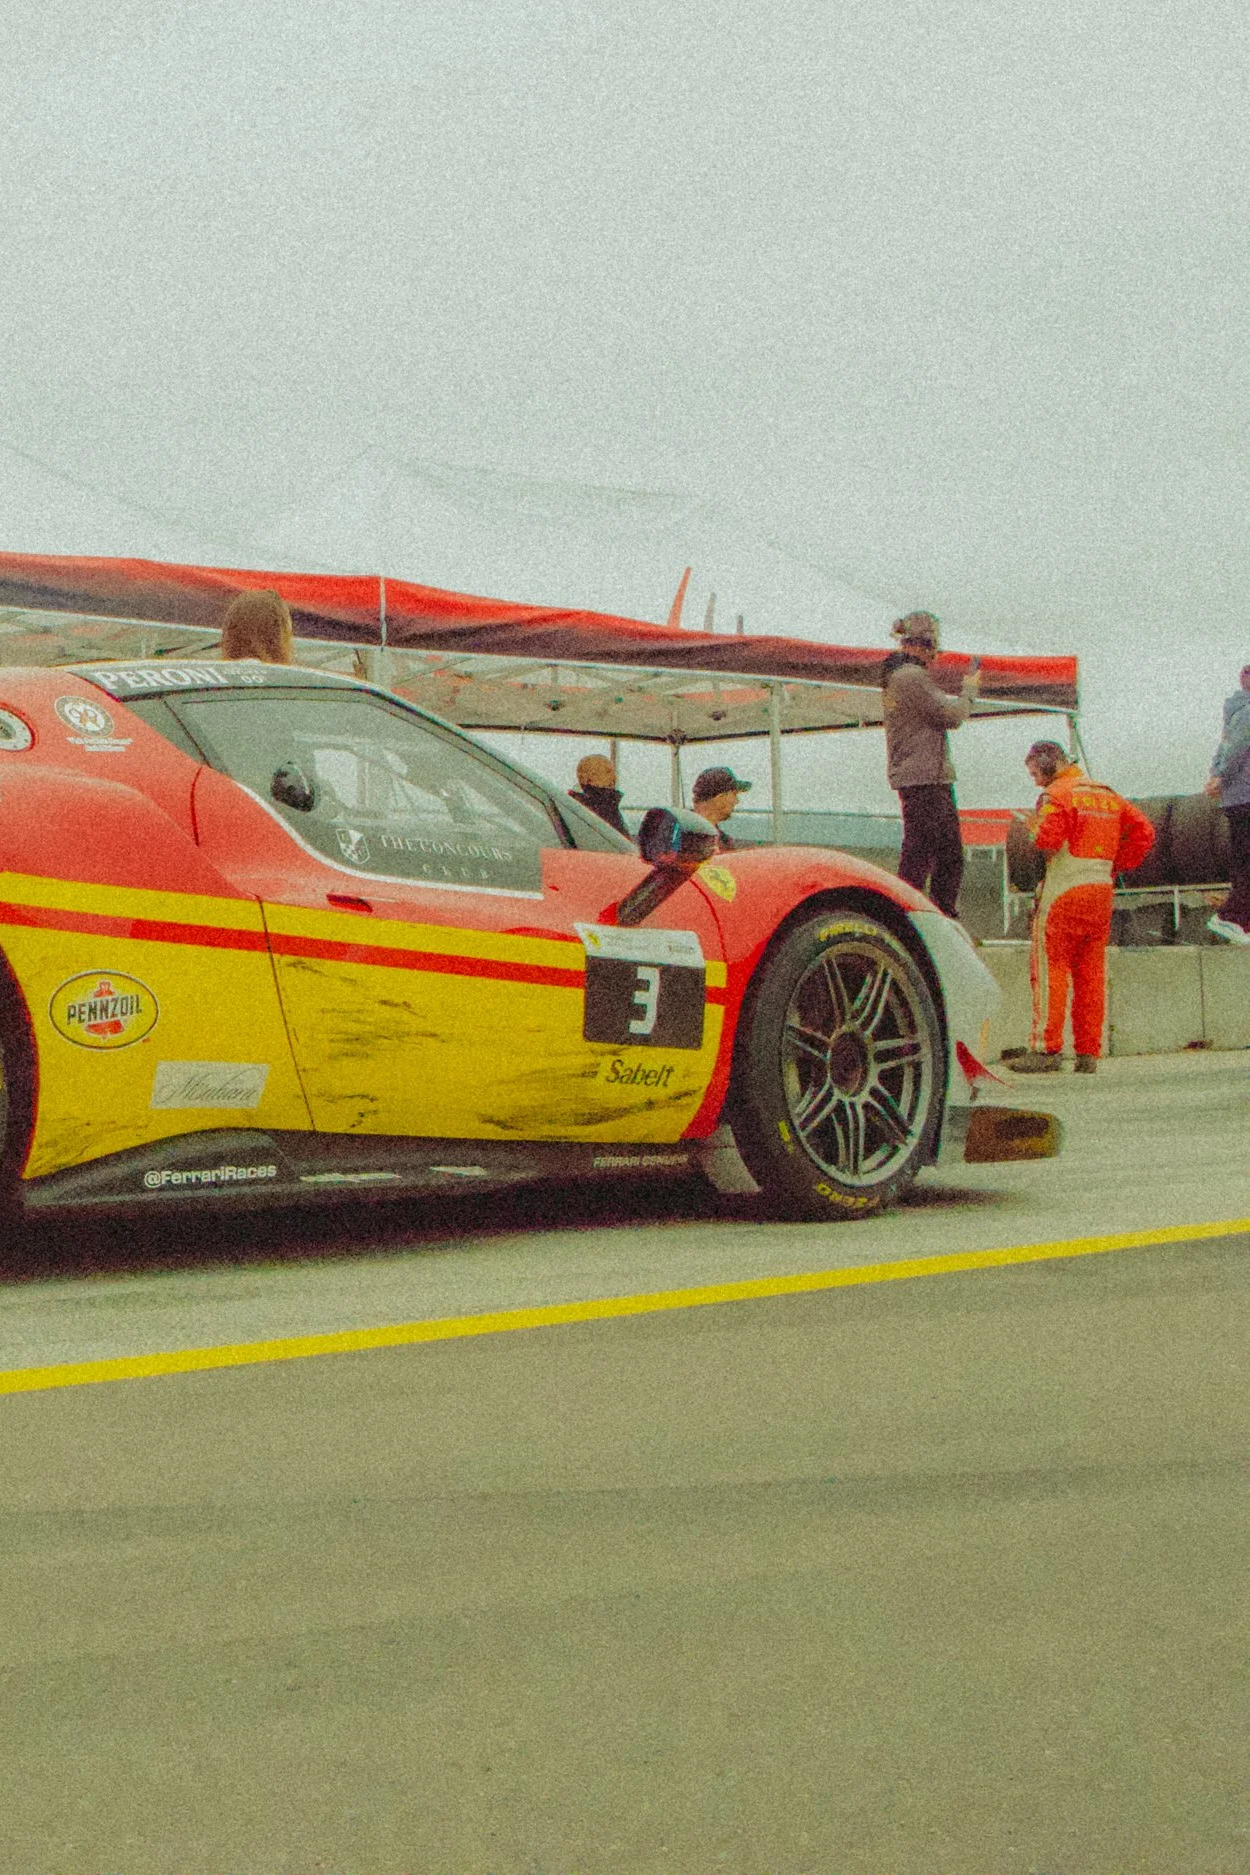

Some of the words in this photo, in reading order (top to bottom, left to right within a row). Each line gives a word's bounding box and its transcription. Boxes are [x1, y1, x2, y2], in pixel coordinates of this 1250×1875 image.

[93, 667, 229, 691] PERONI
[66, 994, 143, 1026] PENNZOIL
[628, 965, 661, 1035] 3
[606, 1059, 675, 1088] Sabelt
[144, 1164, 278, 1188] @FerrariRaces
